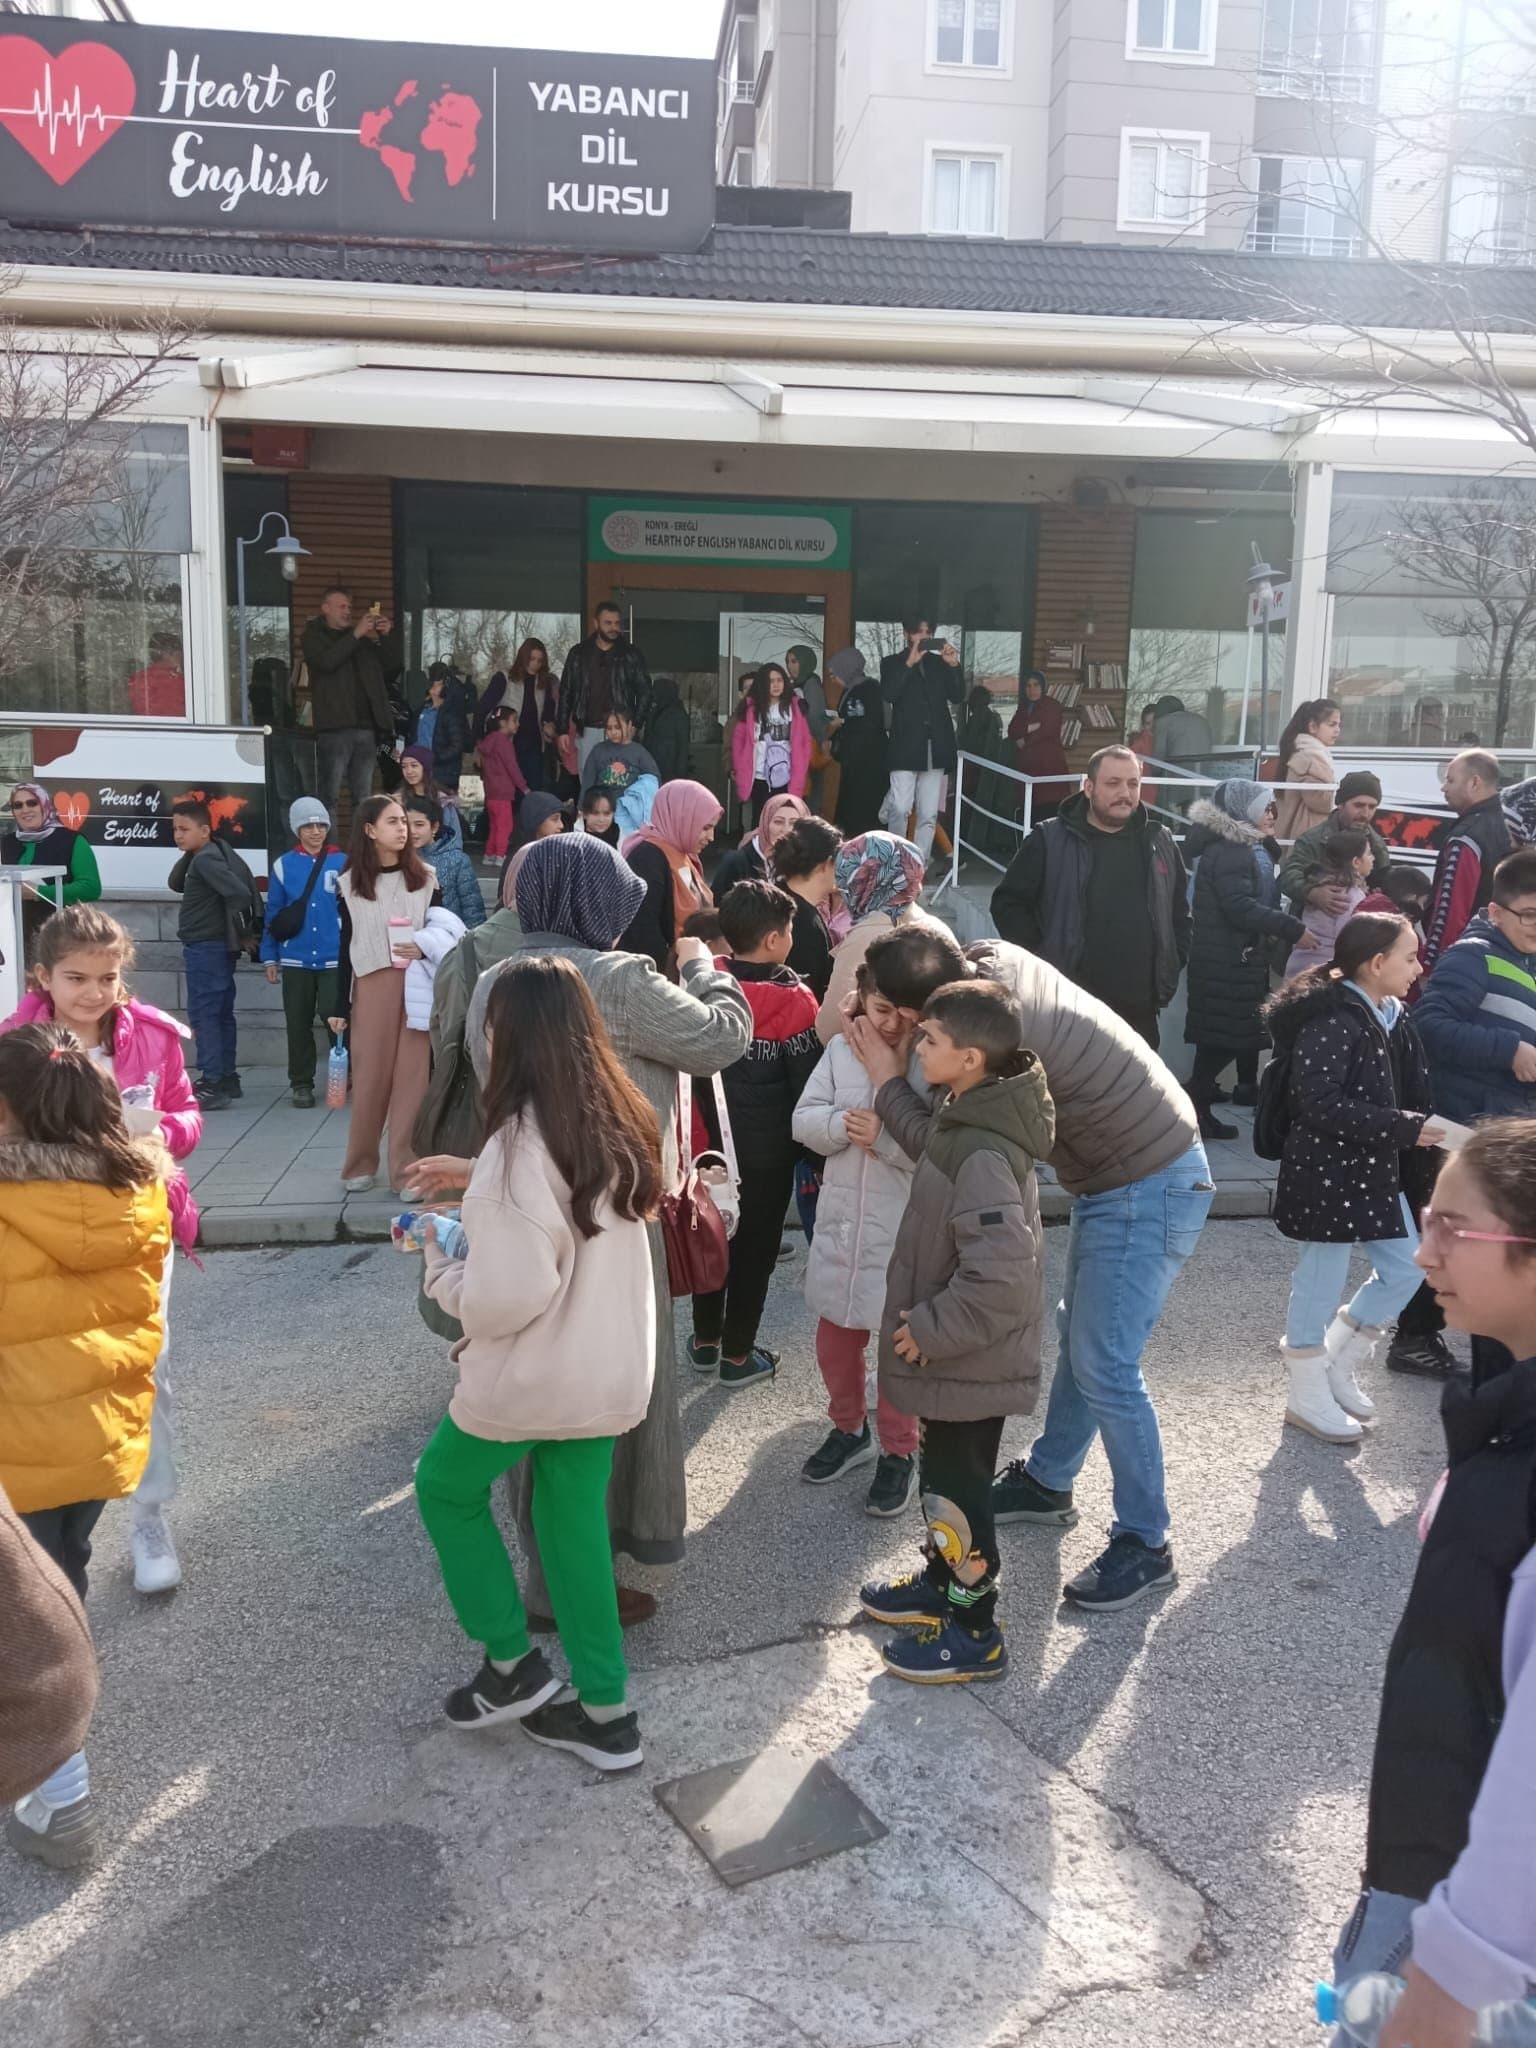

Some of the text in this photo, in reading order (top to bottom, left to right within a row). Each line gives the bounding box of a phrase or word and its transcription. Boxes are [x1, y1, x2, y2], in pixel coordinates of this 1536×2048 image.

[158, 48, 336, 128] Heart of
[528, 81, 689, 119] YABANCI
[581, 127, 638, 167] DİL
[169, 131, 329, 212] English
[546, 182, 670, 217] KURSU
[645, 519, 669, 531] KONYA
[645, 533, 682, 548] HEARTH
[683, 535, 696, 548] OF
[697, 535, 736, 550] ENGLISH
[737, 537, 777, 551] YABANCI
[794, 539, 825, 552] KURSU
[98, 787, 161, 812] Heart of
[104, 821, 160, 844] English
